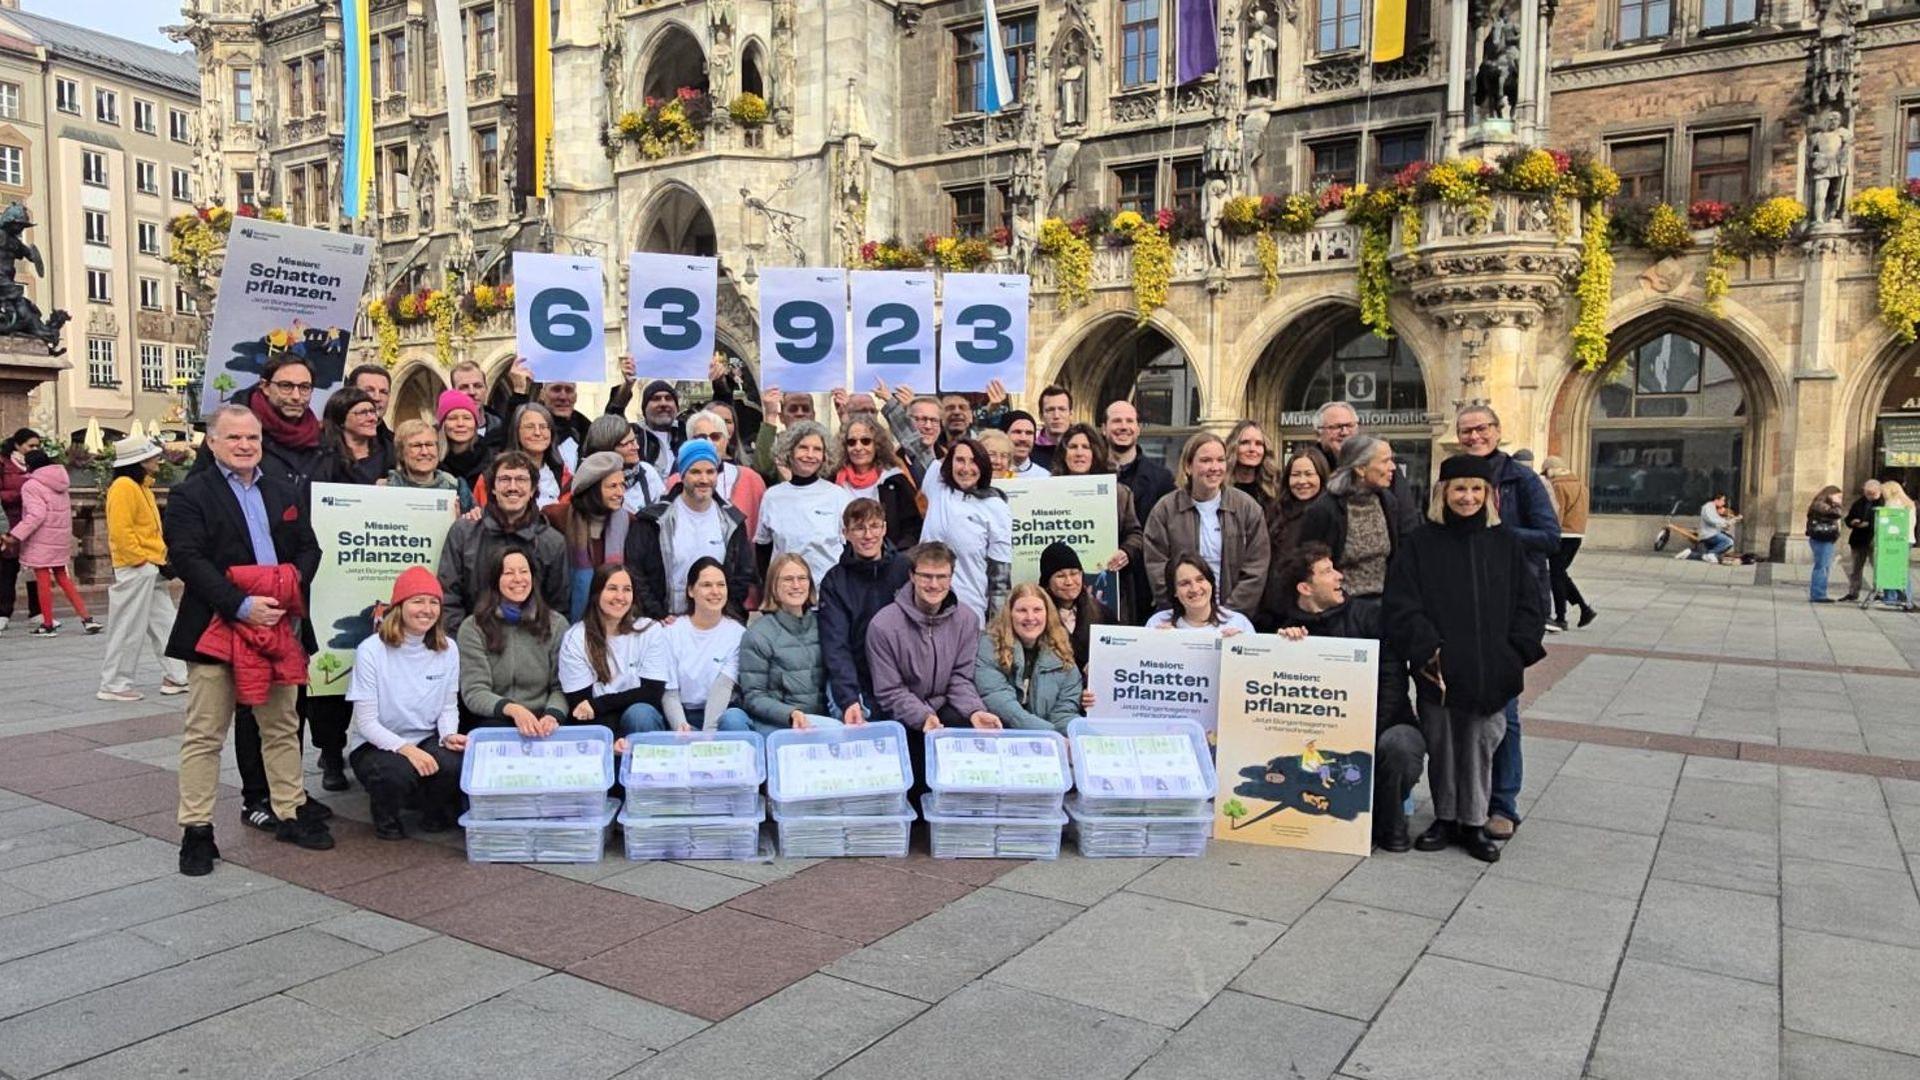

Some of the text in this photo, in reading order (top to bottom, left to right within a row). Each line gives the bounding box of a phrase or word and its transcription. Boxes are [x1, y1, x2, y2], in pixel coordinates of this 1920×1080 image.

[278, 256, 321, 269] Mission:
[250, 262, 341, 287] Schatten
[245, 279, 336, 301] pflanzen.
[529, 287, 1014, 364] 6 3 9 2 3
[1357, 411, 1428, 424] nformatio
[1032, 509, 1072, 517] Mission:
[364, 521, 409, 531] Mission:
[1012, 518, 1094, 532] Schatten
[338, 531, 431, 548] Schatten
[338, 548, 431, 565] pflanzen.
[1140, 660, 1184, 669] Mission:
[1114, 669, 1209, 687] Schatten
[1273, 671, 1321, 682] Mission:
[1113, 685, 1208, 703] pflanzen.
[1245, 680, 1348, 701] Schatten
[1244, 698, 1347, 718] pflanzen.
